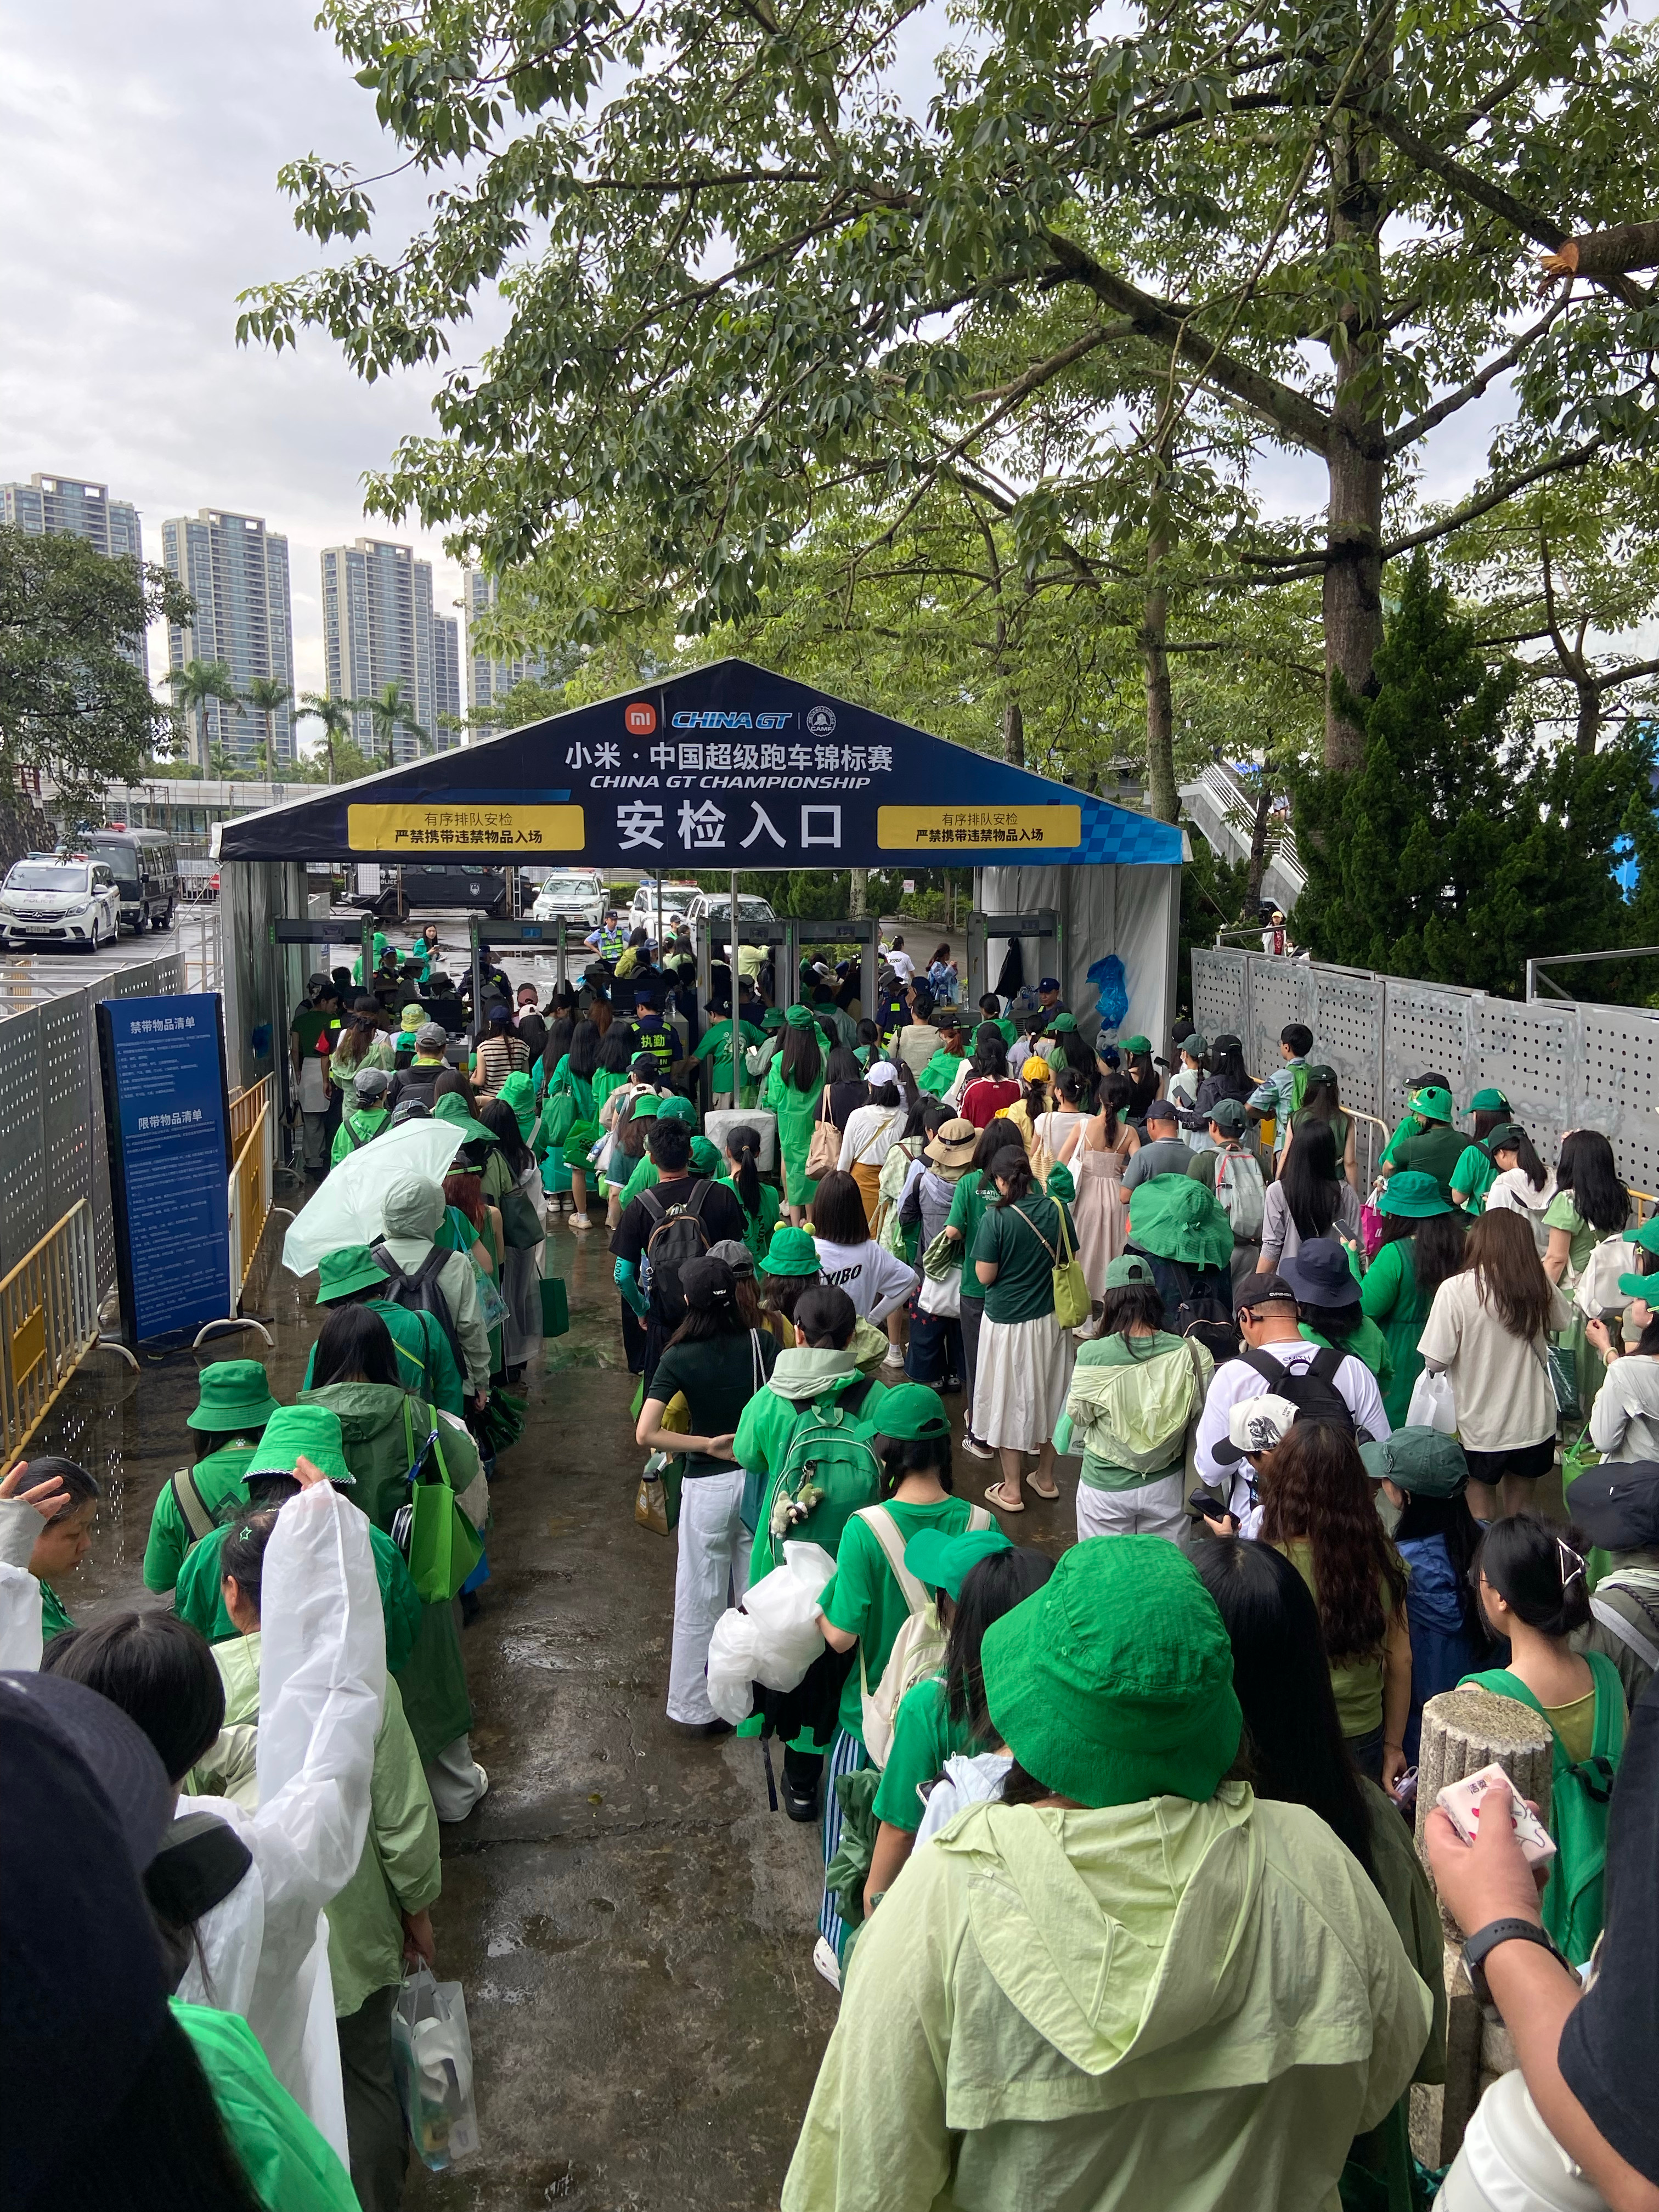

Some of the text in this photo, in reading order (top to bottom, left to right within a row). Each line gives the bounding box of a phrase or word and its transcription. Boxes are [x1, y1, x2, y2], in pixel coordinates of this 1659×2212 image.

[672, 712, 753, 729] CHINA
[755, 712, 793, 729] GT
[590, 775, 871, 789] CHINA GT CHAMPIONSHIP
[425, 812, 513, 826] 有序排队安检
[617, 799, 841, 850] 安检入口
[941, 812, 1018, 826] 有序排队安检
[395, 829, 543, 844] 严禁携带违禁物品入场
[916, 828, 1043, 843] 严禁携带违禁物品入场
[130, 1017, 195, 1034] 禁带物品清单
[641, 1034, 665, 1048] 执勤
[138, 1109, 202, 1130] 限带物品清单
[820, 1264, 862, 1285] YIBO
